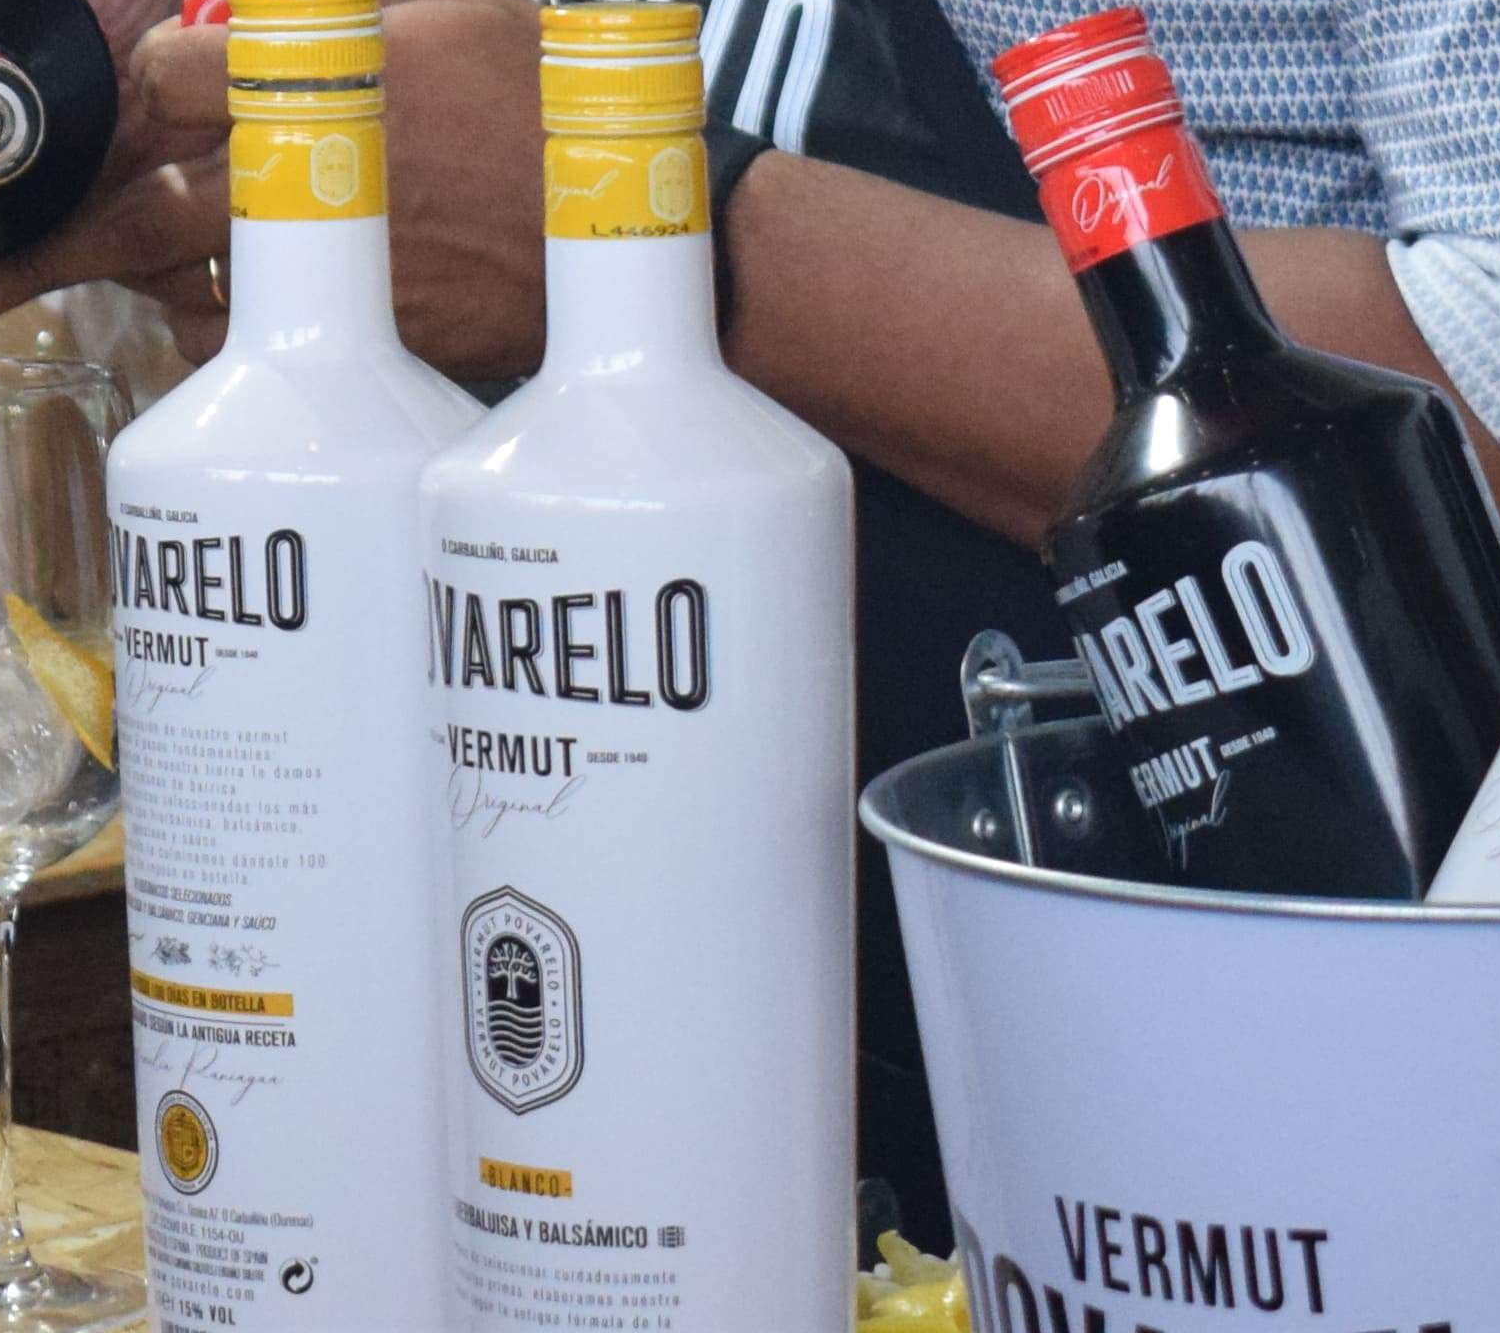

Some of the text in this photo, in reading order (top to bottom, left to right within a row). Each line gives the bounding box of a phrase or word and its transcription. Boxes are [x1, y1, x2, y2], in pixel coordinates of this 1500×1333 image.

[511, 546, 559, 564] GALICIA
[124, 626, 209, 668] VERMUT
[448, 723, 578, 777] VERMUT
[587, 752, 620, 764] DESDE
[273, 765, 323, 781] damos
[298, 852, 328, 869] 100
[504, 913, 560, 991] POVARELO
[191, 990, 207, 1009] EN
[211, 993, 266, 1014] BOTELLA
[176, 1021, 188, 1039] LA
[191, 1024, 241, 1045] ANTIGUA
[245, 1030, 297, 1047] RECETA
[475, 1007, 562, 1087] VERMUT POVARELO
[522, 1219, 534, 1241] Y
[538, 1218, 649, 1249] BALSÁMICO
[1054, 1195, 1329, 1314] VERMUT
[554, 1268, 678, 1285] cuidadosamente
[179, 1299, 204, 1320] 15%
[209, 1304, 236, 1326] VOL
